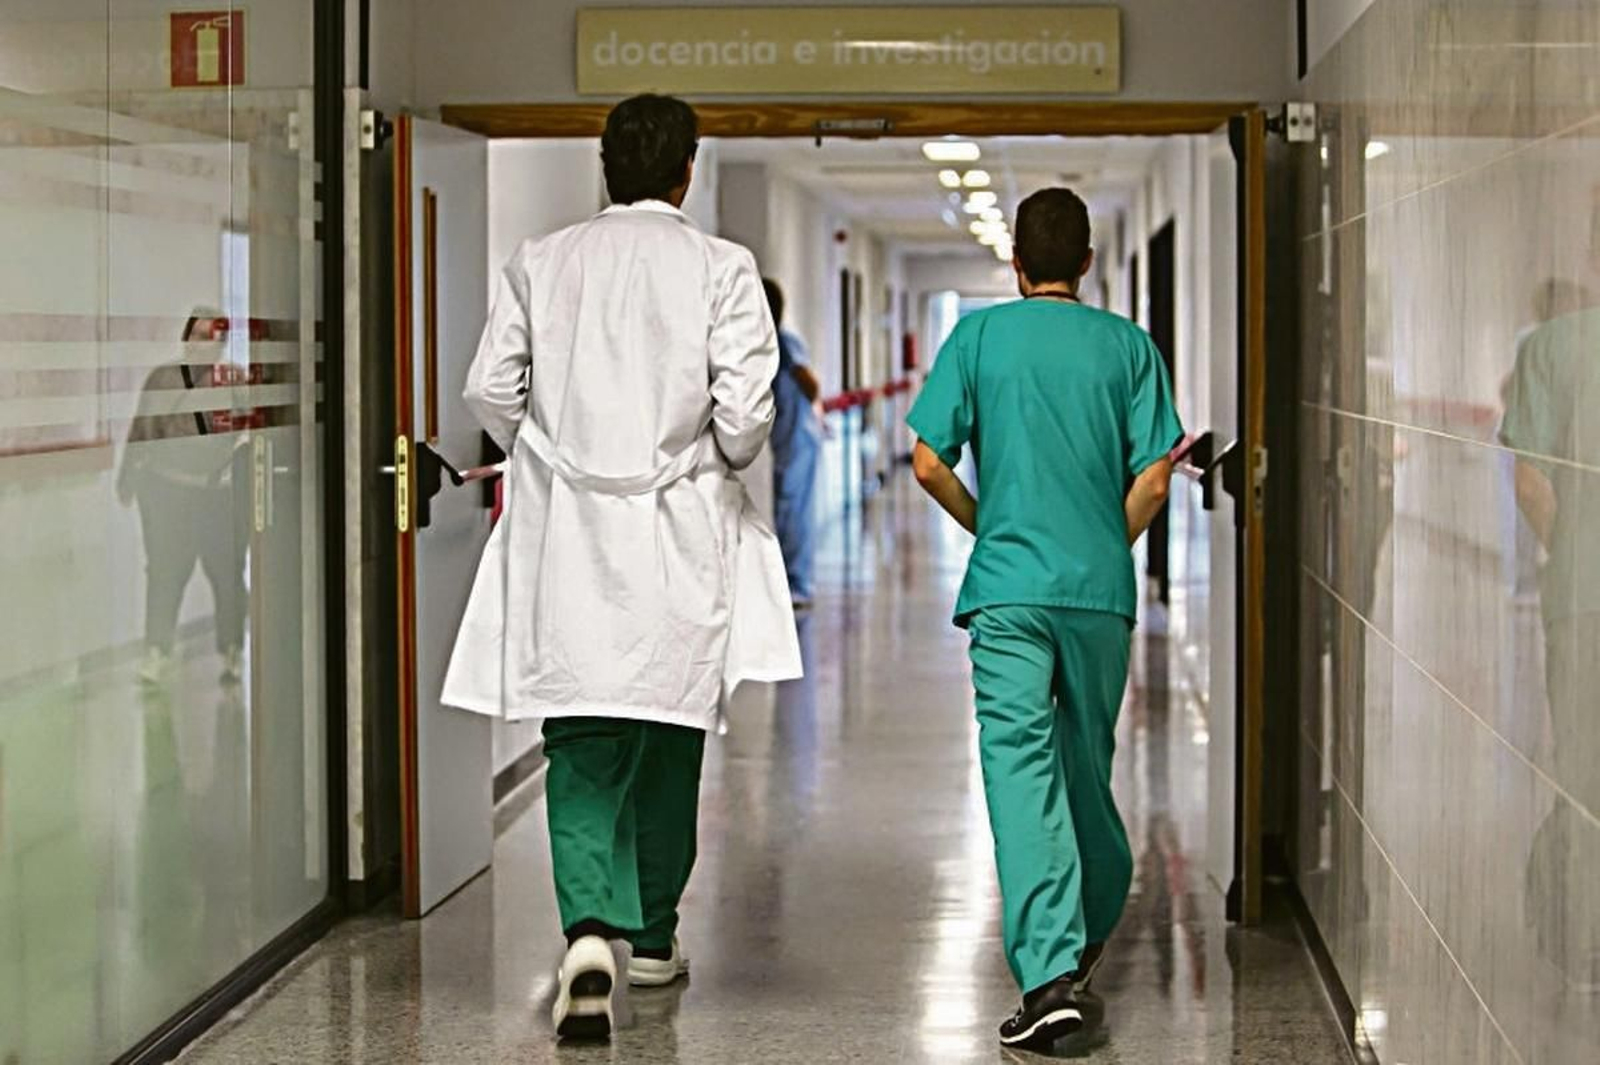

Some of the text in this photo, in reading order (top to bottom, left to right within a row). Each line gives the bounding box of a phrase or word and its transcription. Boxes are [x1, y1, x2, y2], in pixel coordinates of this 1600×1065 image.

[593, 28, 1107, 74] docencia e investigación
